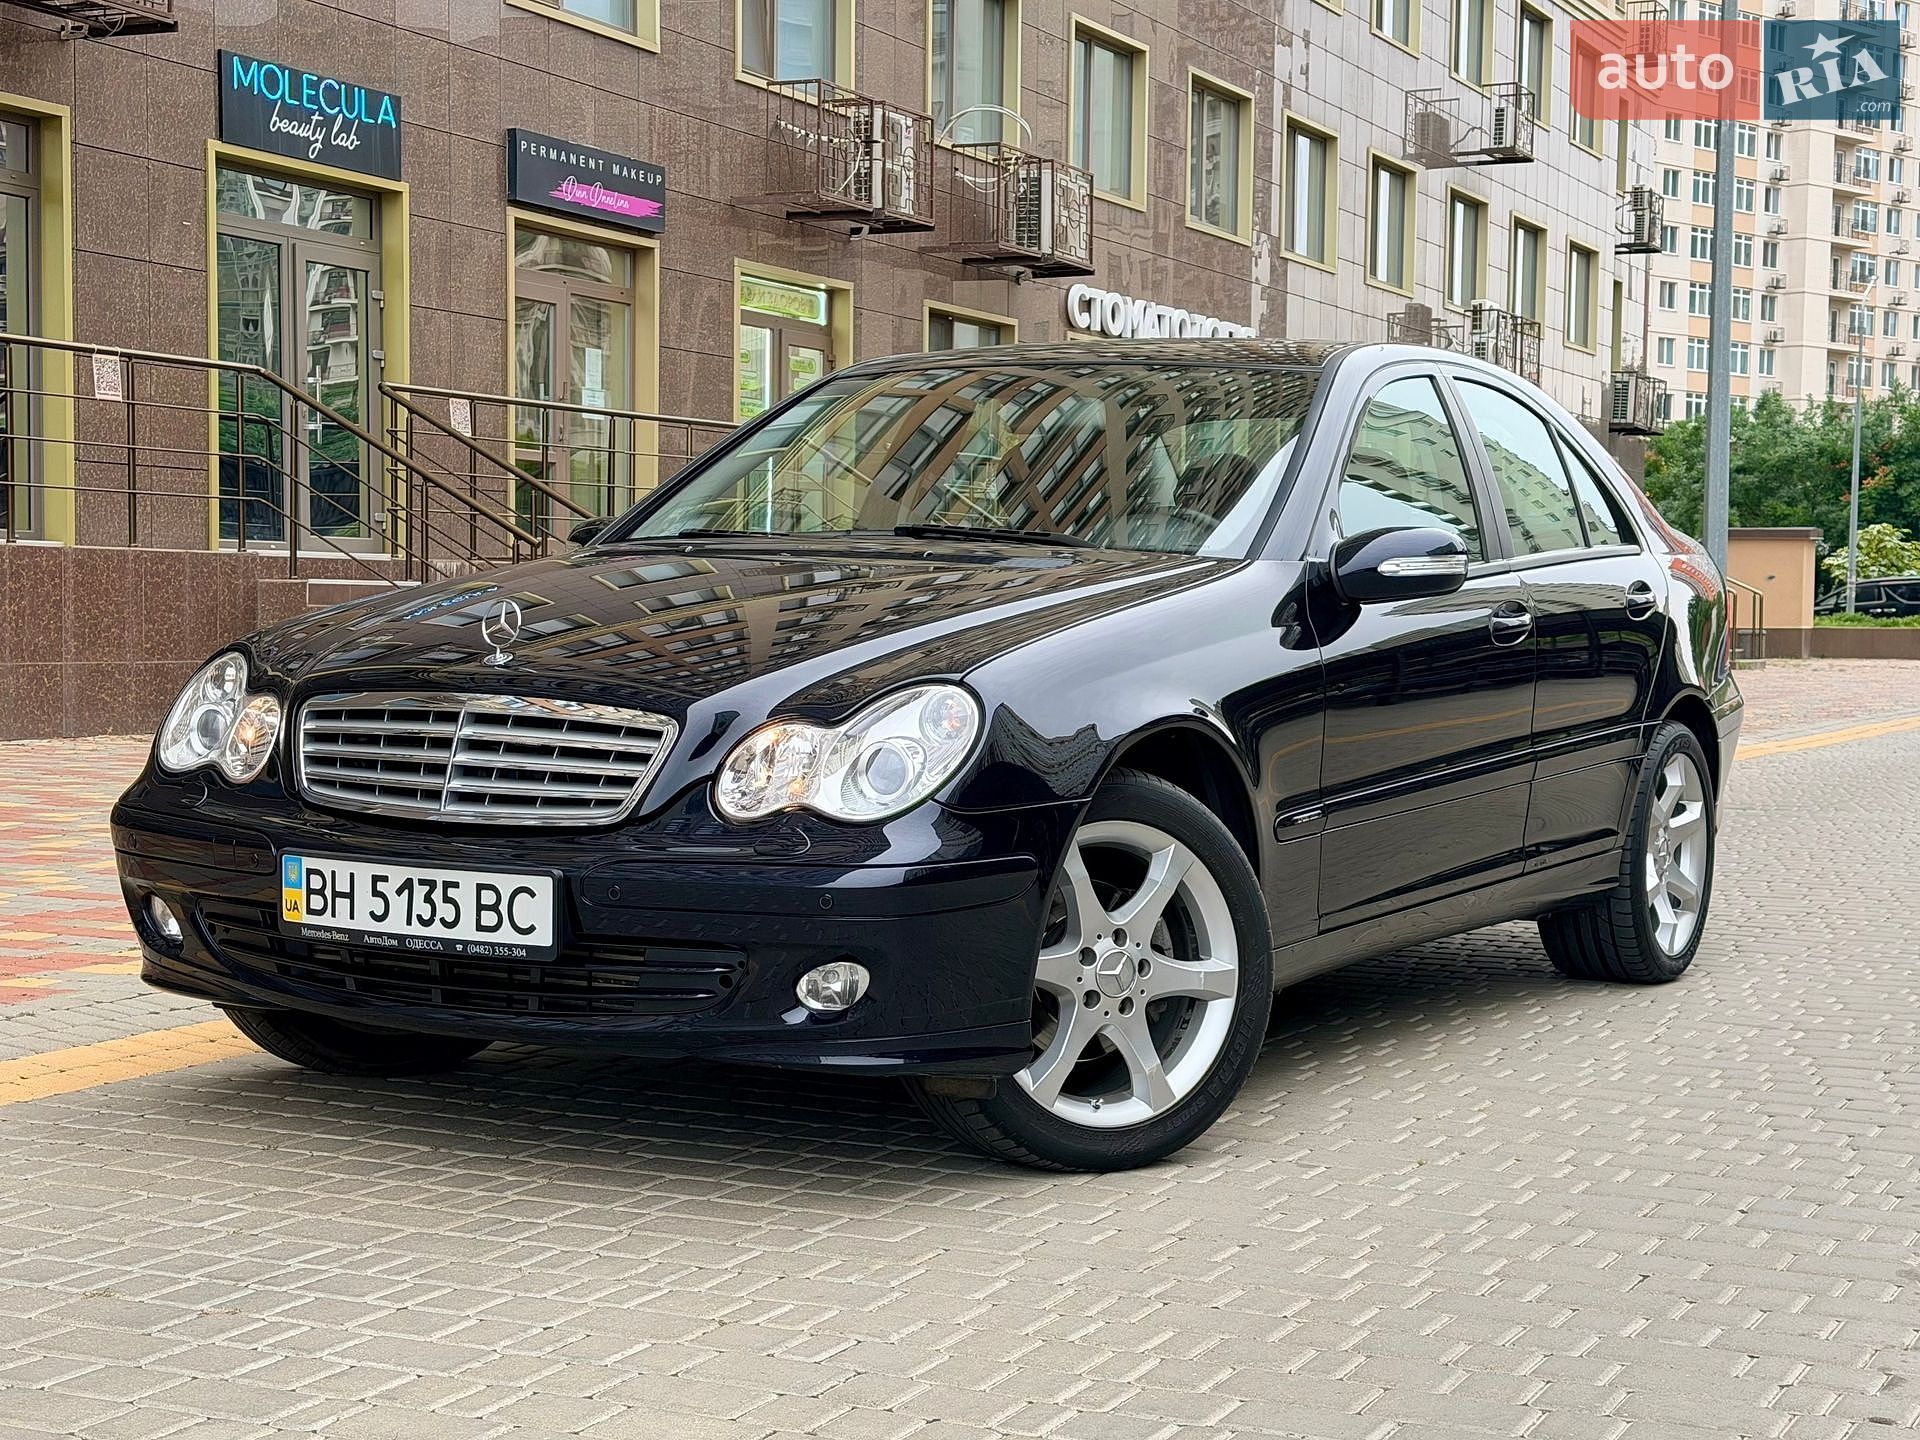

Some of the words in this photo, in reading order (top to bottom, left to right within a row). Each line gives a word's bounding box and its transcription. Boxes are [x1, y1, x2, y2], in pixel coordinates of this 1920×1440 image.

[232, 55, 397, 129] MOLECULA
[269, 99, 327, 159] beauty
[330, 112, 361, 150] lab
[520, 140, 605, 172] PERMANENT
[612, 163, 663, 187] MAKEUP
[284, 898, 301, 914] UA
[305, 867, 355, 921] BH
[368, 873, 462, 930] 5135
[474, 882, 538, 936] BC
[301, 926, 350, 942] Mercedes-Benz
[363, 934, 399, 947] АвтоДом
[405, 937, 444, 951] ОДЕССА
[467, 943, 493, 957] (0482)
[494, 945, 527, 958] 355-304
